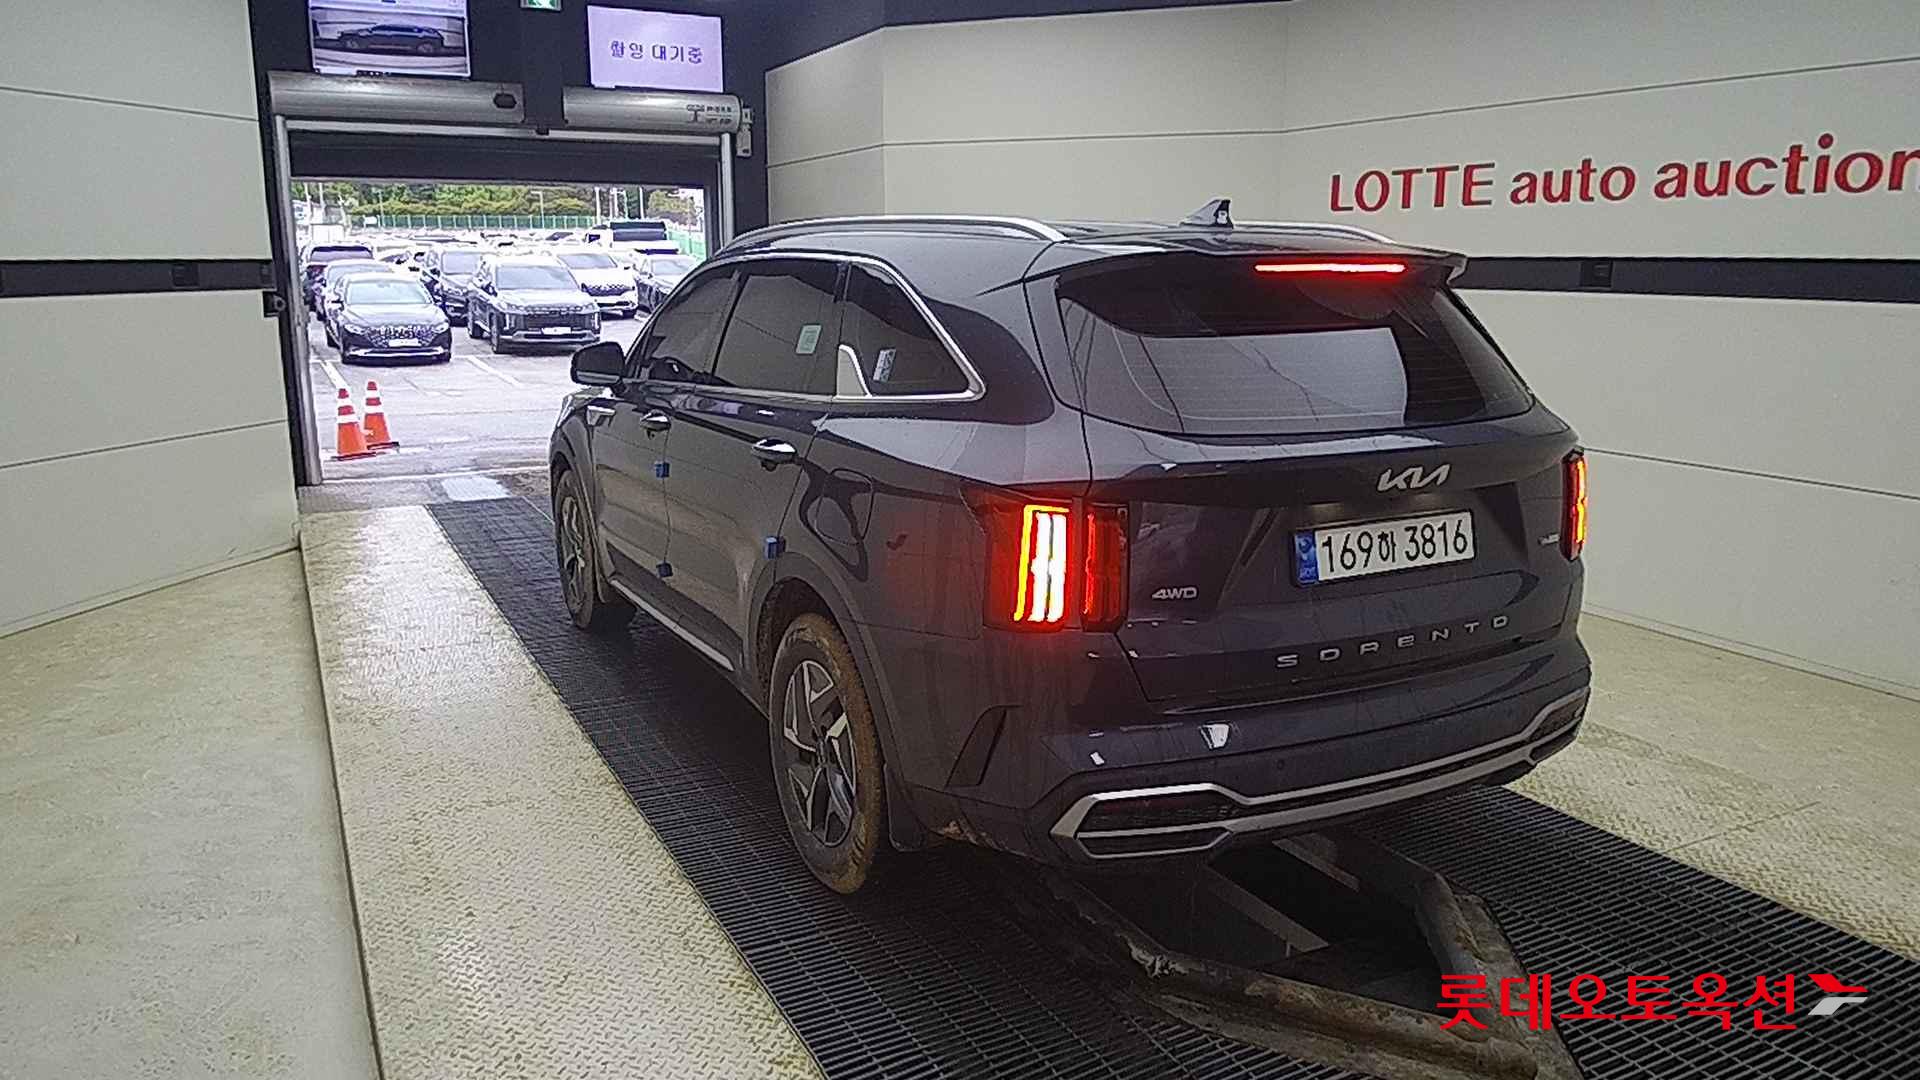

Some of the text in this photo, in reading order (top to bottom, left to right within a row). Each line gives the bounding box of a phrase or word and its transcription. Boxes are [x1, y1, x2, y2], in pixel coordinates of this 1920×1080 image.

[652, 44, 703, 64] 대기중
[1331, 164, 1496, 212] LOTTE
[1510, 158, 1637, 205] auto
[1404, 520, 1468, 562] 3816
[1152, 587, 1198, 599] 4WD
[1276, 615, 1511, 668] SORENTO
